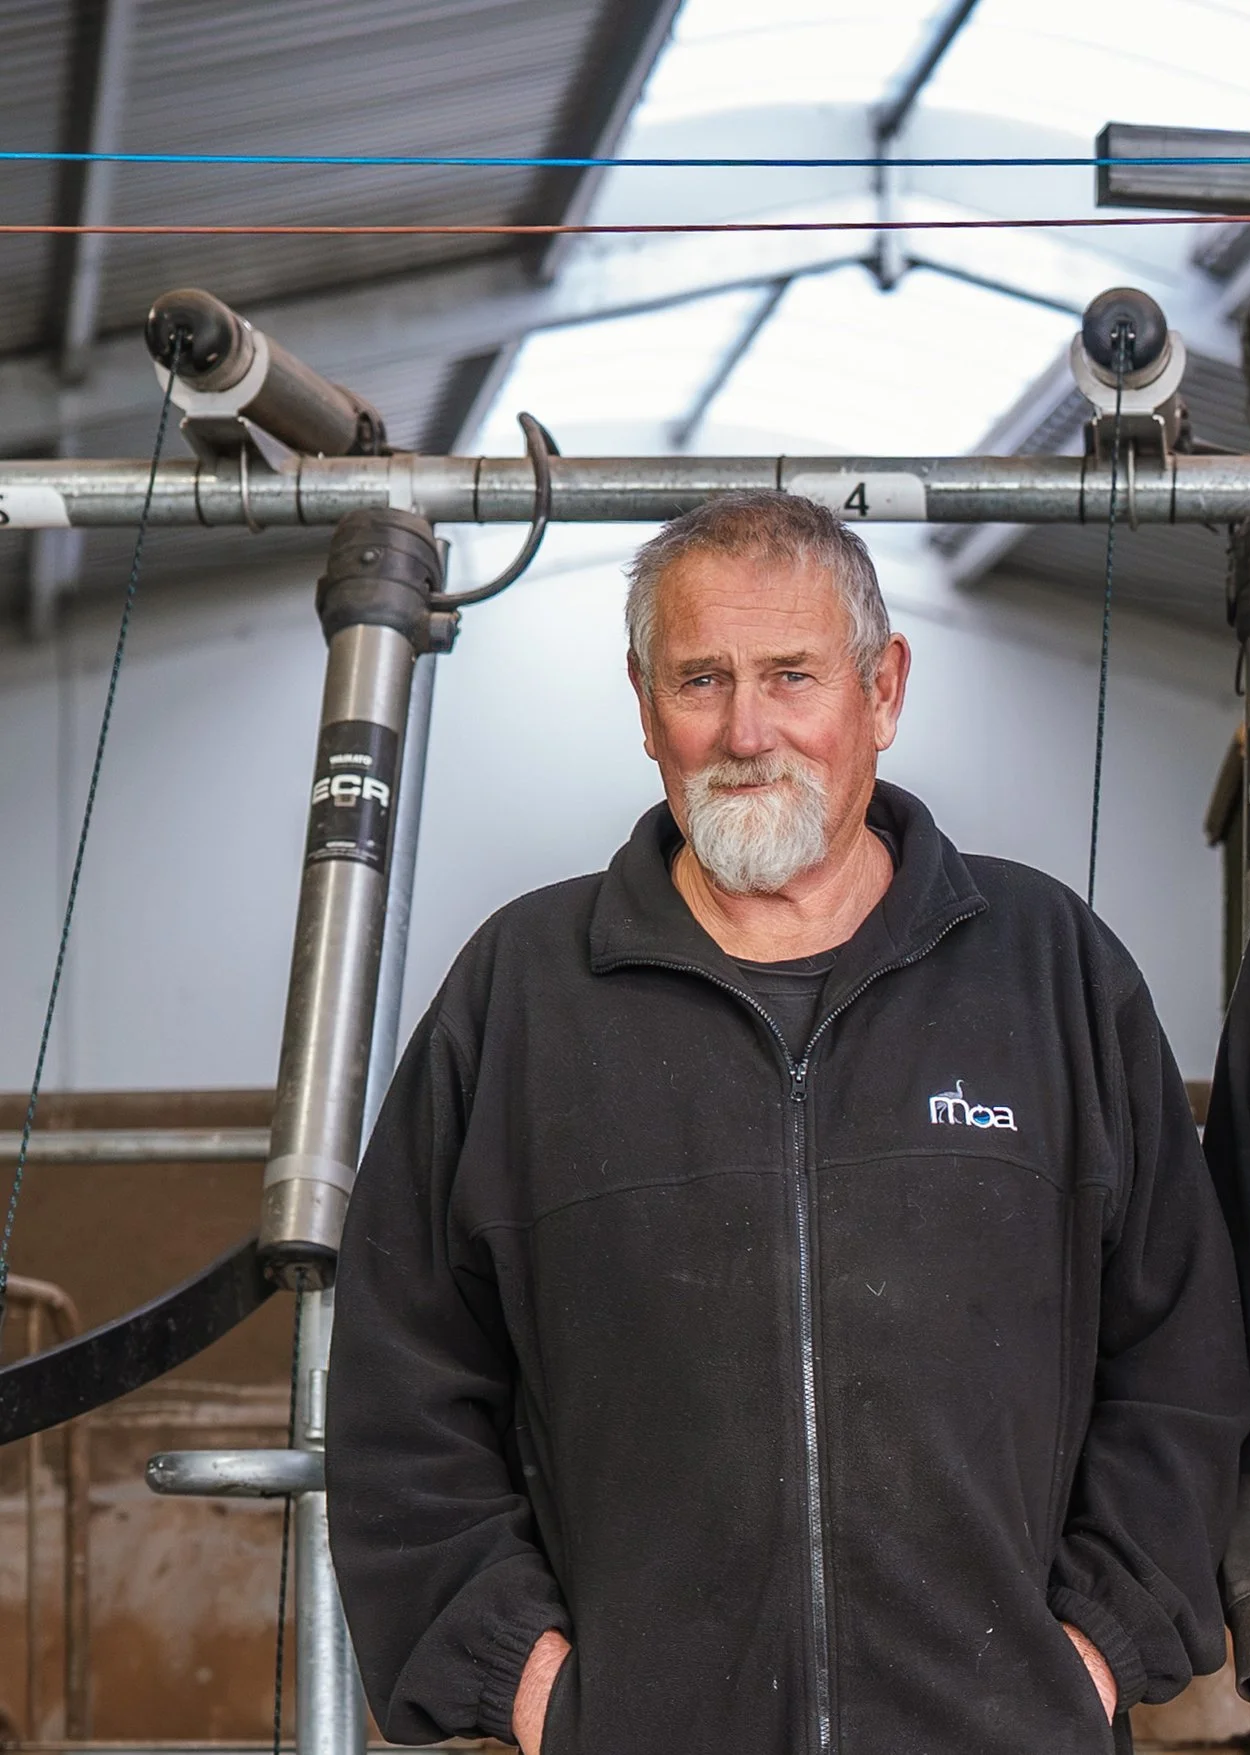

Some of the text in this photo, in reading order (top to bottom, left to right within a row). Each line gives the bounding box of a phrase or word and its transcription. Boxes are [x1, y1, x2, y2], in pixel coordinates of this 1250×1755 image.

[844, 482, 869, 516] 4
[312, 773, 390, 808] ECR
[929, 1096, 1018, 1131] moa
